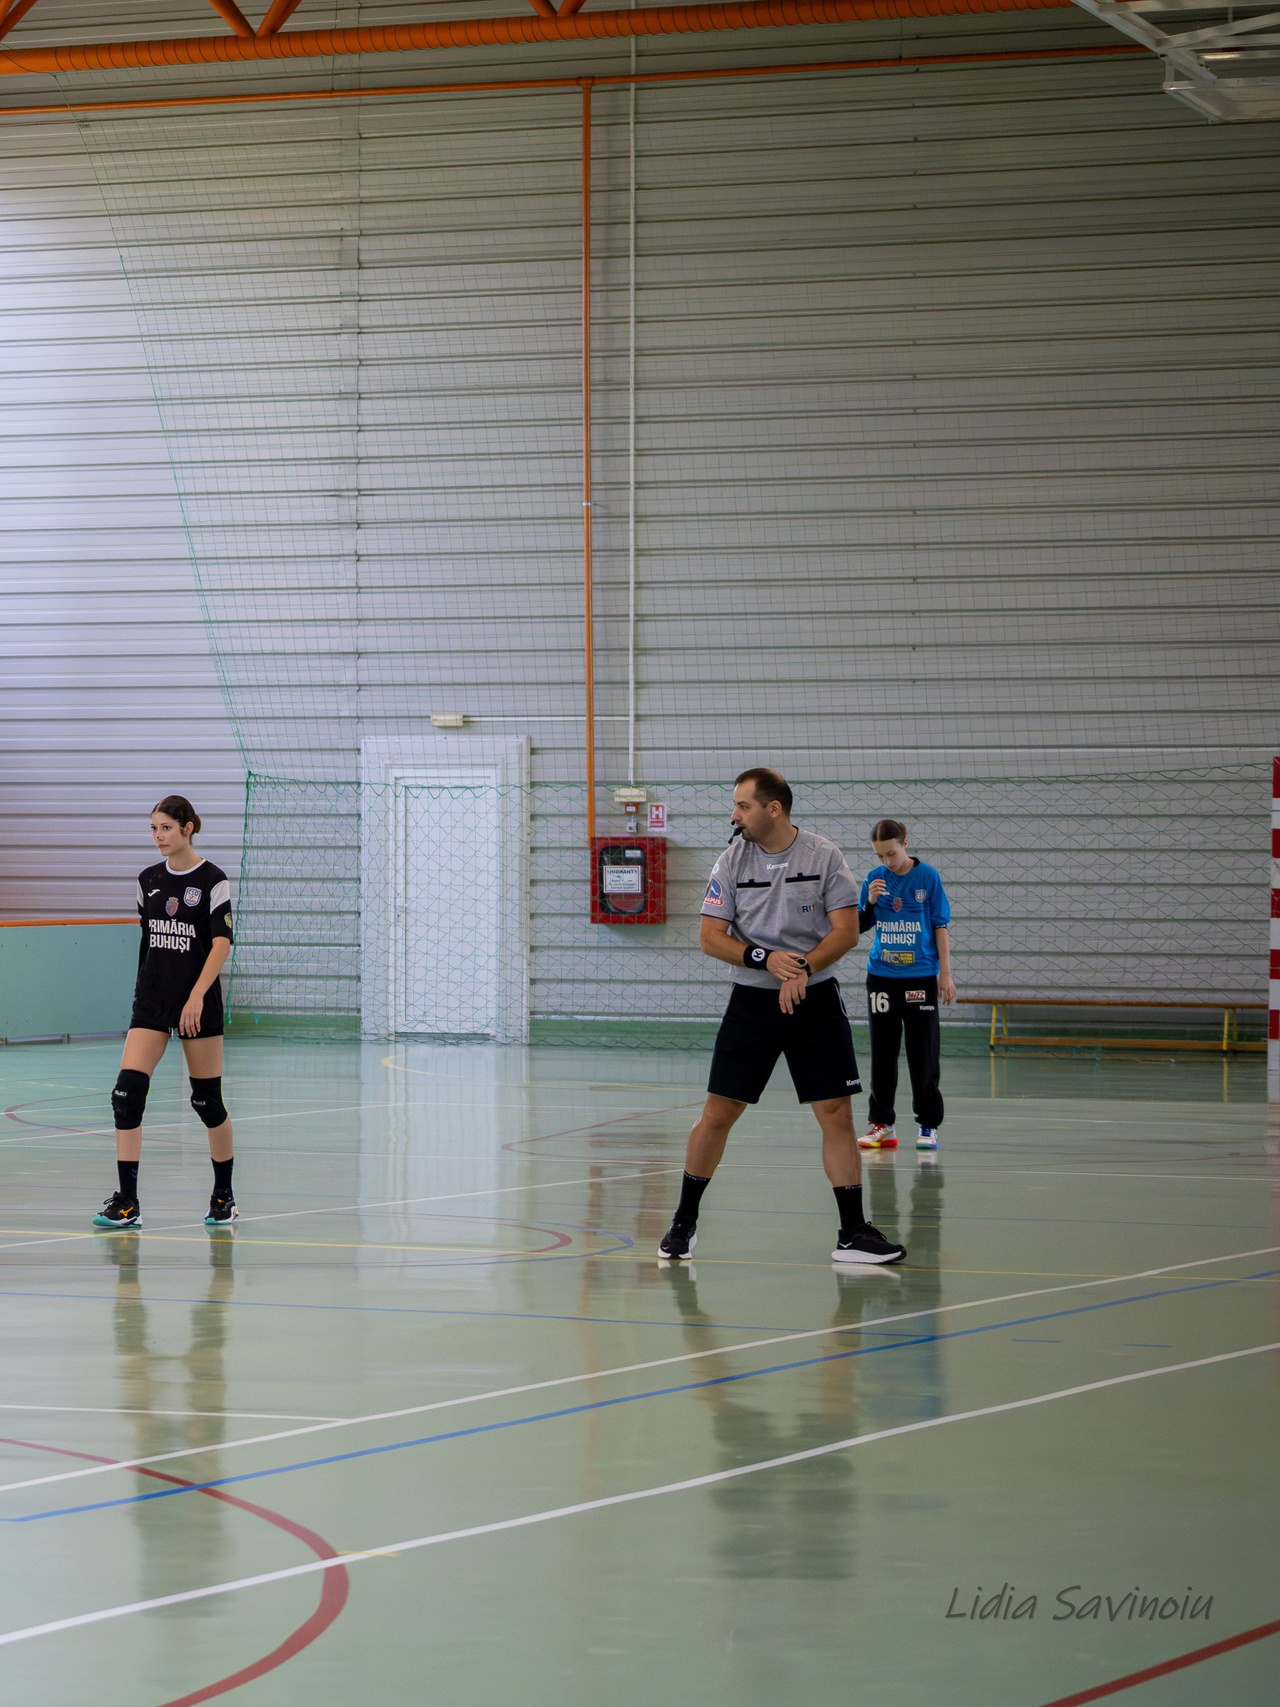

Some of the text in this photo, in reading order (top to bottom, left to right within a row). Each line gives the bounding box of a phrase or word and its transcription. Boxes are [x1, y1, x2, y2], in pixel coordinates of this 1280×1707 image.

[651, 806, 663, 819] H
[876, 919, 922, 932] PRIMĂRIA
[149, 934, 191, 954] BUHUȘI
[880, 933, 916, 946] BUHUȘI
[869, 991, 890, 1014] 16
